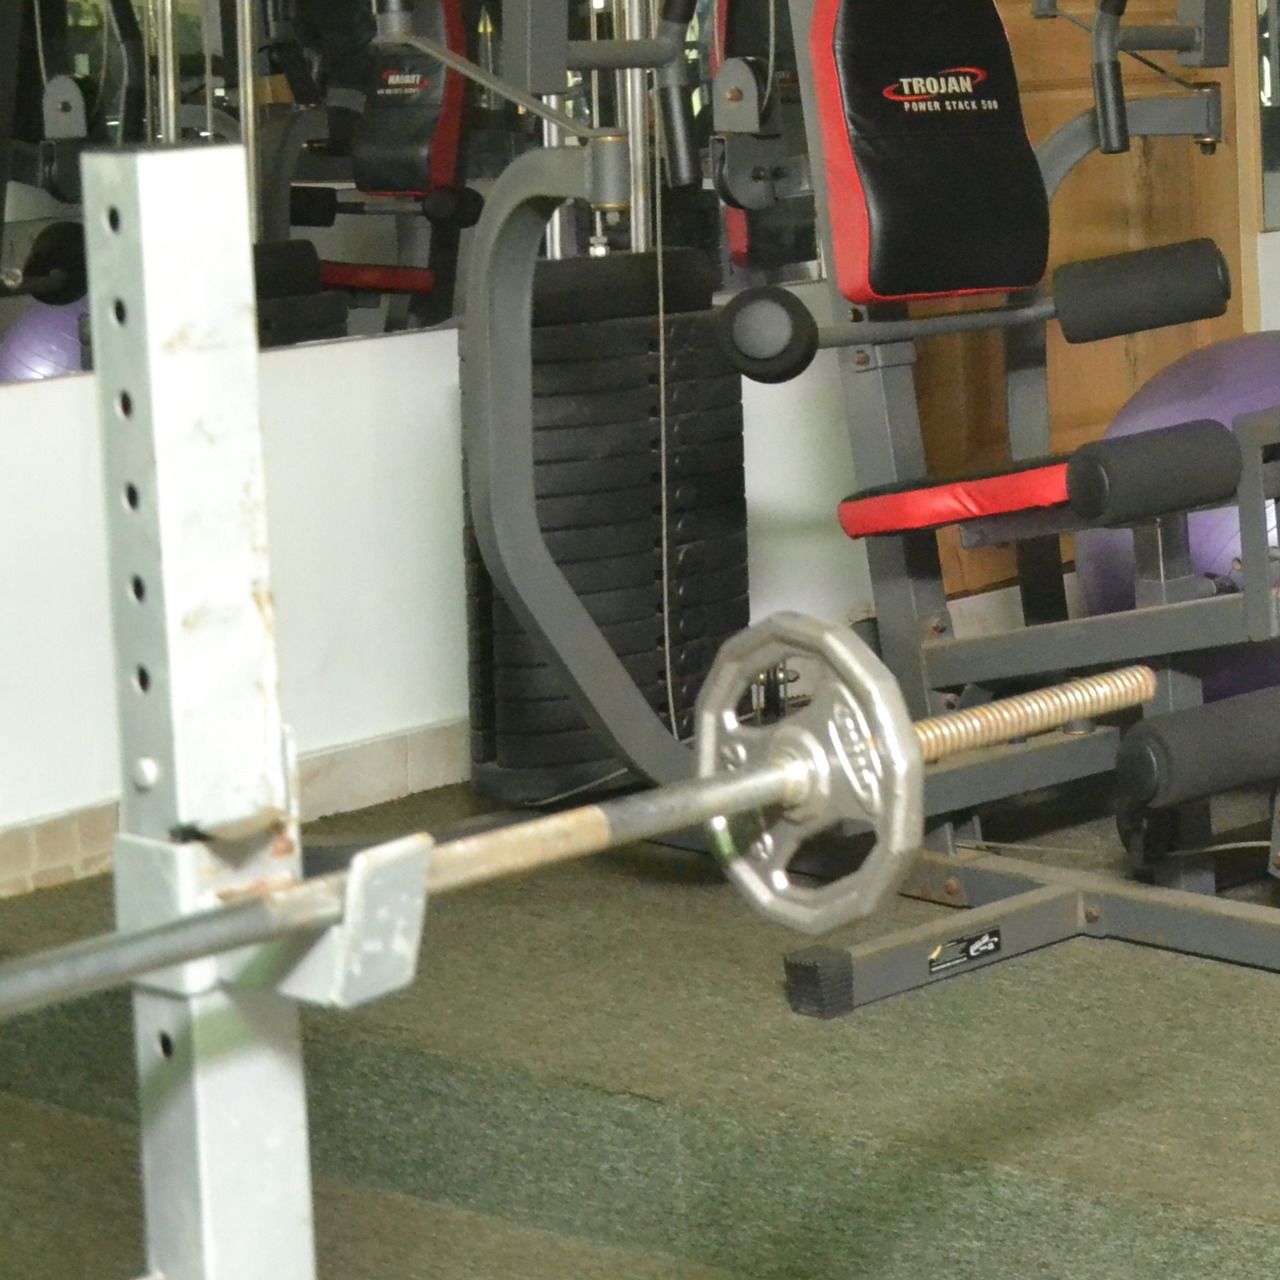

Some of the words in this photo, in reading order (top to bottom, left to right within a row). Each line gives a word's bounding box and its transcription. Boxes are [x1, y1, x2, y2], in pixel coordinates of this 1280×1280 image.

[899, 76, 973, 95] TROJAN
[904, 101, 941, 112] POWER
[945, 100, 978, 111] STACK
